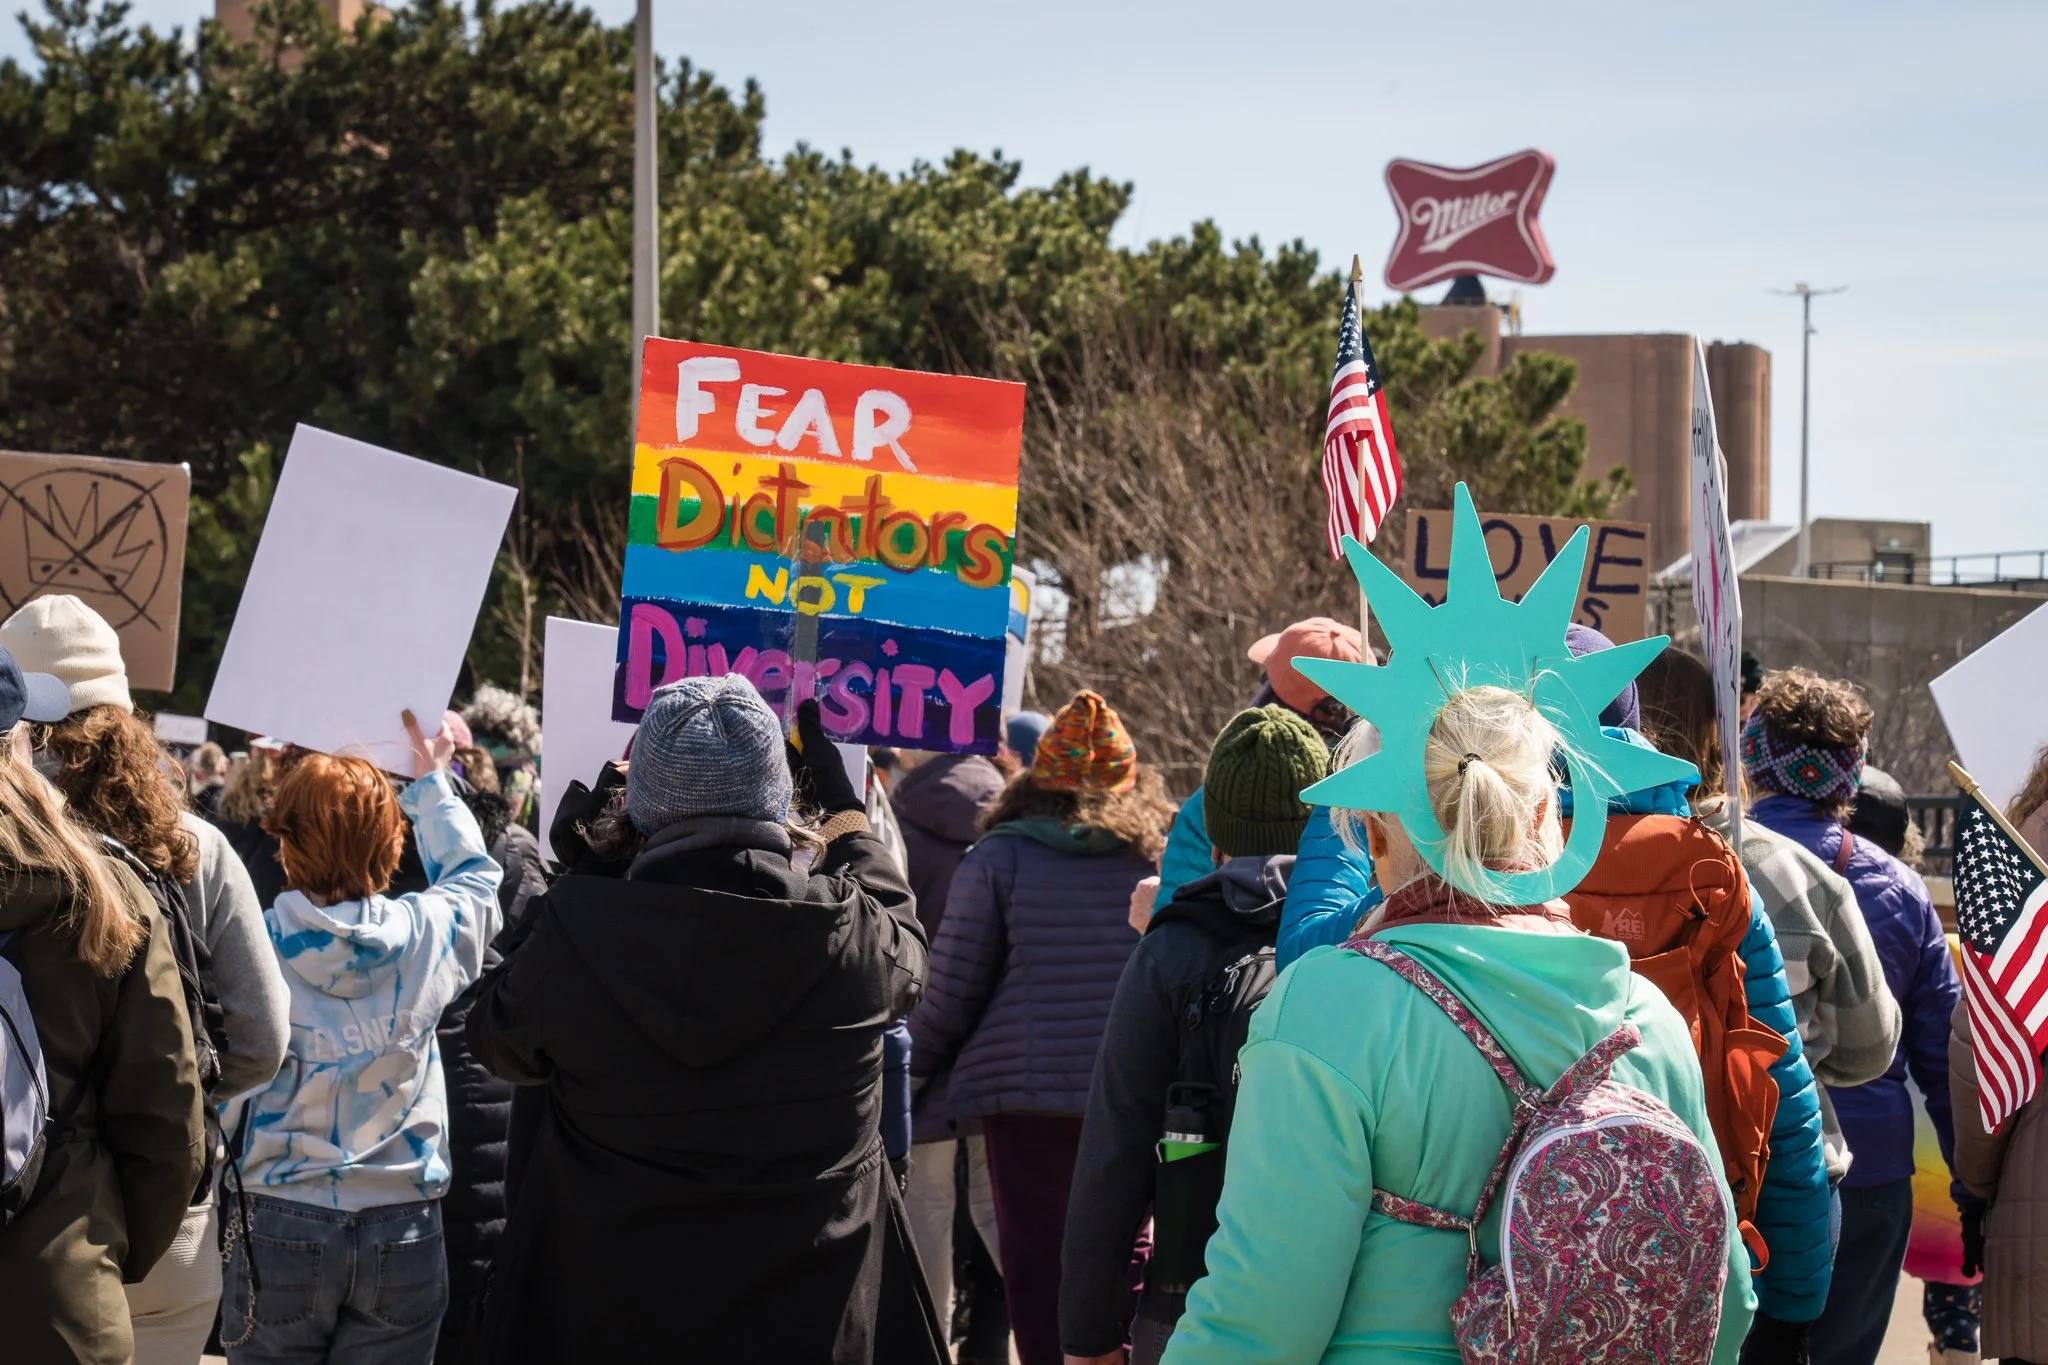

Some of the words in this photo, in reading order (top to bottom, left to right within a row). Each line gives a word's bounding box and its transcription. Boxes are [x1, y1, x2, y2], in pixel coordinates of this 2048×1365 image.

[1410, 190, 1518, 245] Miller
[675, 356, 918, 473] FEAR
[655, 456, 1009, 588] Dictators
[745, 564, 887, 616] NOT
